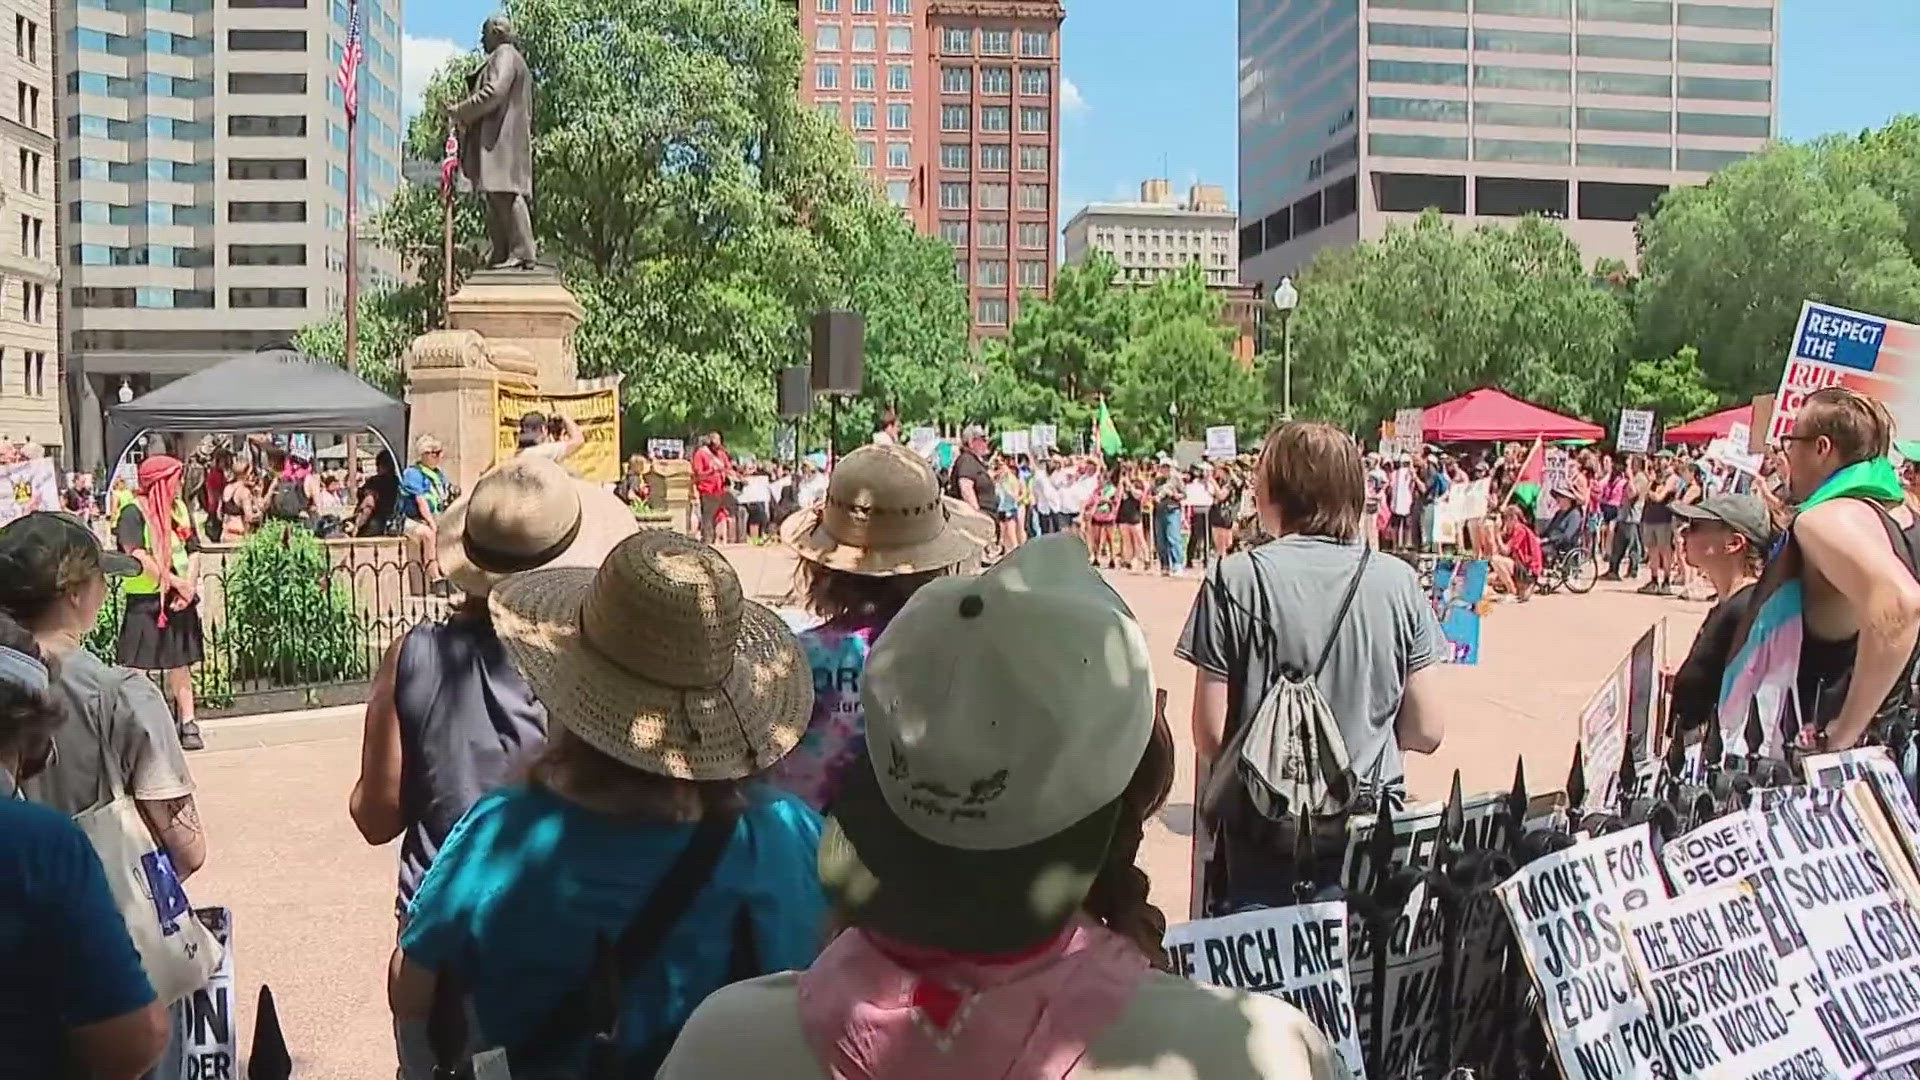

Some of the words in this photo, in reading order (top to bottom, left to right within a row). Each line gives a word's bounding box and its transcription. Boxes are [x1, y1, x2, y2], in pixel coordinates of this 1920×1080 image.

[1803, 336, 1836, 359] THE
[1807, 312, 1881, 345] RESPECT
[1516, 854, 1603, 922] MONEY
[1604, 839, 1650, 888] FOR
[1784, 848, 1890, 910] SOCIALIS
[1204, 927, 1285, 987] RICH
[1292, 919, 1343, 978] ARE
[1537, 902, 1622, 978] JOBS
[1633, 921, 1678, 970] THE
[1670, 908, 1723, 960] RICH
[1719, 895, 1761, 943] ARE
[1826, 944, 1863, 980] AND
[1844, 899, 1920, 970] LGBT
[1556, 955, 1638, 1029] EDUCA
[1650, 942, 1778, 1030] DESTROYING
[1841, 964, 1920, 1029] LIBERA
[1574, 1033, 1622, 1080] NOT
[1619, 1014, 1664, 1068] FOR
[1668, 1024, 1721, 1076] OUR
